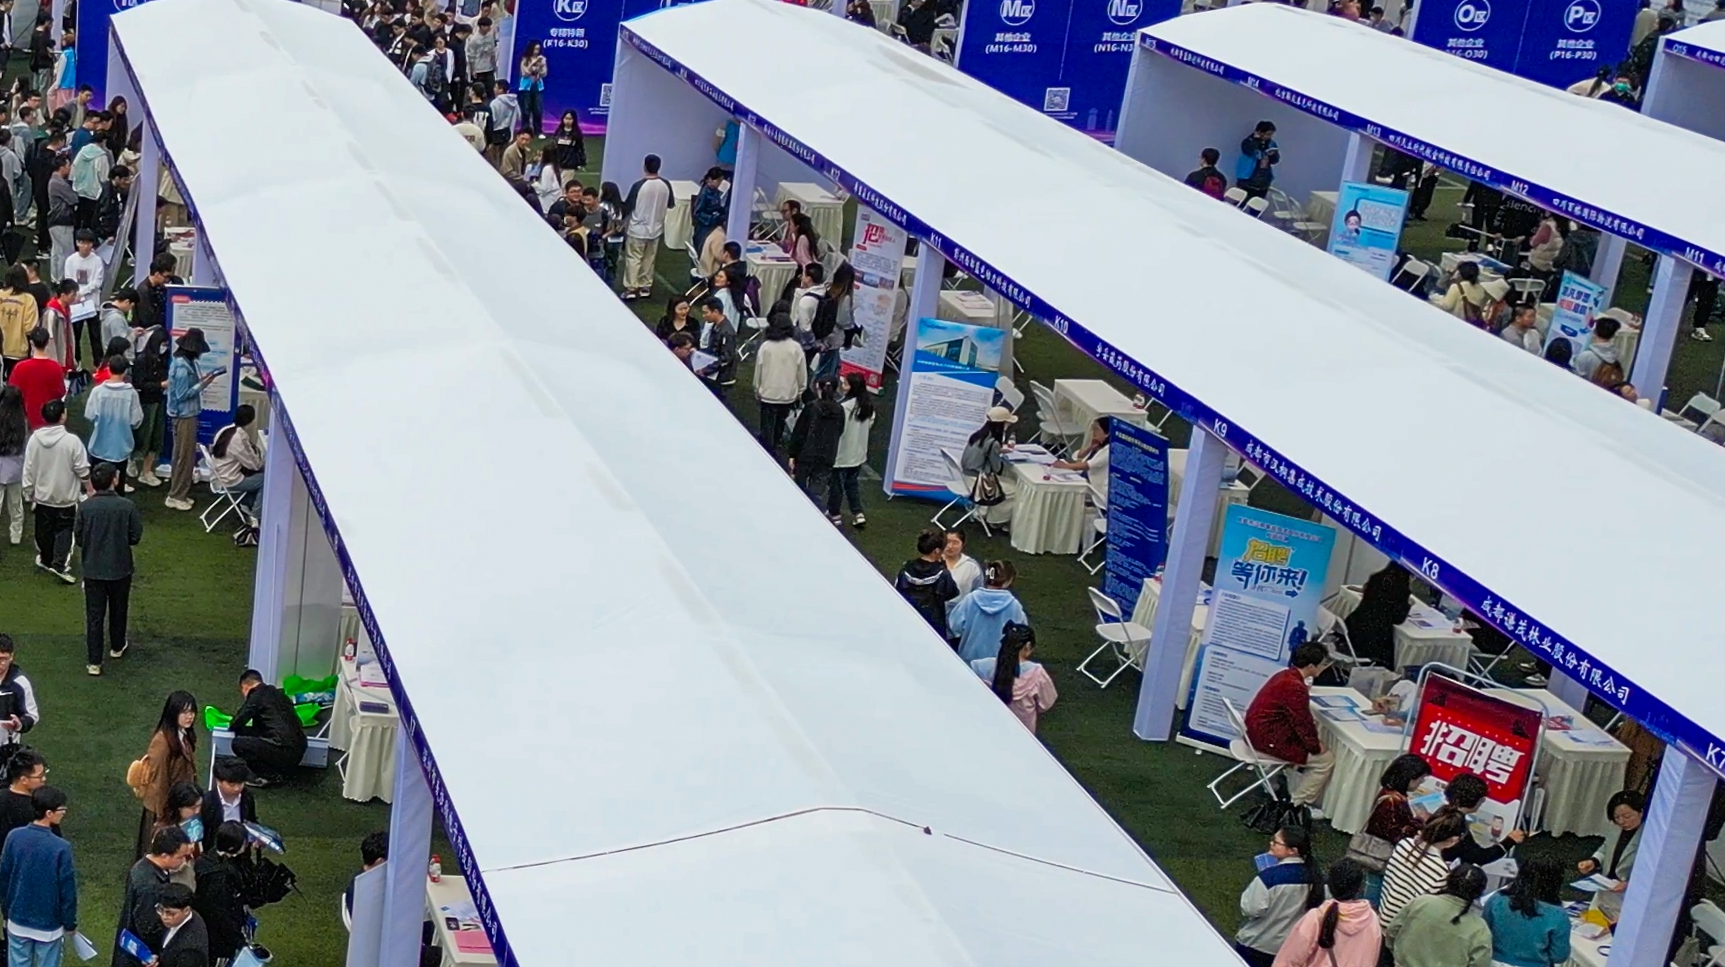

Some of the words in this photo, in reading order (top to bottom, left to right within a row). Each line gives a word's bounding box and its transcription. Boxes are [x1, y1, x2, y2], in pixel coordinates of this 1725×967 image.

[1002, 0, 1034, 18] M区
[1456, 4, 1487, 24] O区
[1568, 5, 1596, 24] P区
[542, 38, 589, 49] (K16-K30)
[994, 31, 1032, 43] 其他企业
[1446, 38, 1485, 48] 其他企业
[1556, 38, 1596, 49] 其他企业
[984, 43, 1038, 54] (M16-M30)
[1549, 49, 1598, 61] (P16-P30)
[1511, 179, 1530, 196] M12
[930, 231, 943, 250] K11
[1684, 246, 1707, 266] M11
[1054, 314, 1070, 334] K10
[1213, 417, 1228, 438] K9
[1244, 438, 1383, 542] 成都市汉桐集成技术股份有限公司
[1230, 560, 1309, 591] 等你来!
[1421, 556, 1440, 580] K8
[1420, 719, 1527, 785] 招聘
